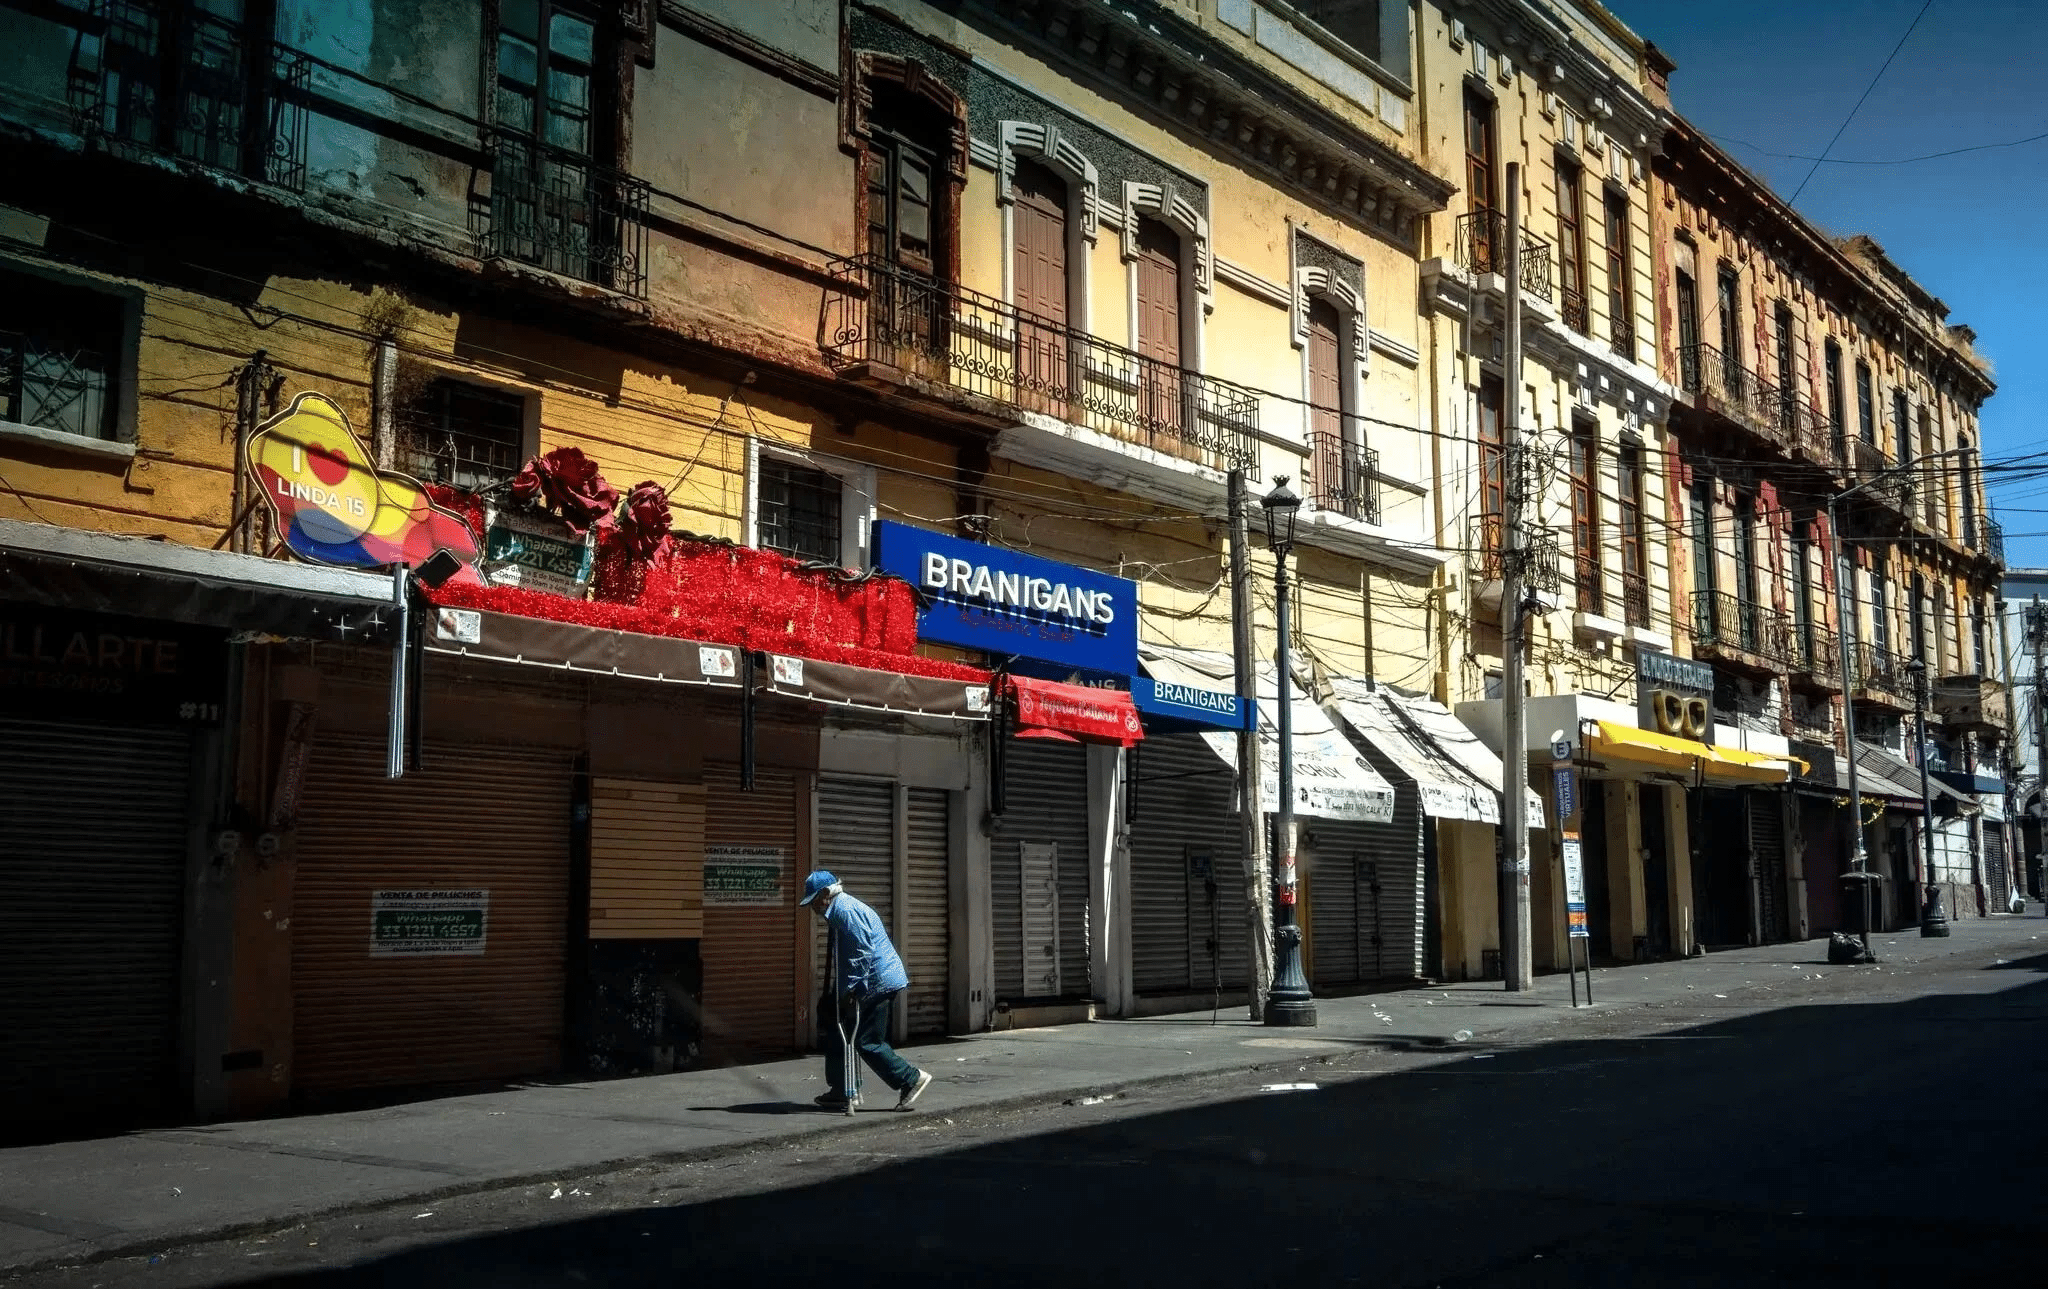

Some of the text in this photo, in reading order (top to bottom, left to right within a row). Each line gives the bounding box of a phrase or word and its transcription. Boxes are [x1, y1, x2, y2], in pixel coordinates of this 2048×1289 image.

[293, 445, 301, 473] I
[277, 476, 365, 517] LINDA 15
[922, 552, 1114, 624] BRANIGANS
[0, 622, 178, 675] LLARTE
[1154, 681, 1236, 712] BRANIGANS
[704, 847, 728, 855] VENTA
[705, 878, 720, 889] 33
[722, 878, 745, 889] 1221
[380, 891, 482, 899] VENTA DE PELUCHES
[396, 914, 465, 924] Whatsapp
[381, 924, 478, 938] 33 1221 4557
